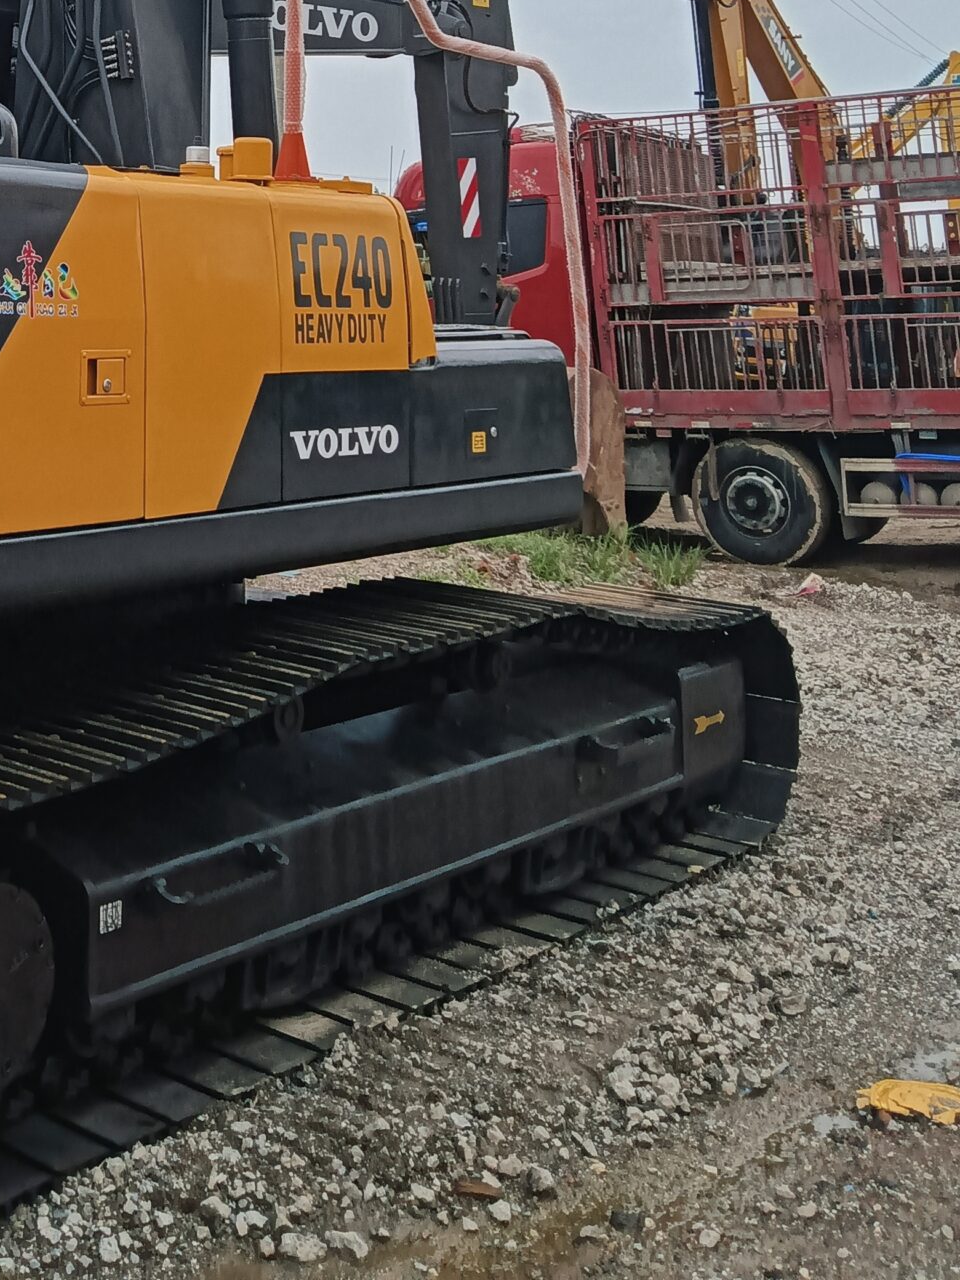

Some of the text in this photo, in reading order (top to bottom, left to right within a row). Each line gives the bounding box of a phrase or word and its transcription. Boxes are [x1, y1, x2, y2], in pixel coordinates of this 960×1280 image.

[271, 0, 378, 42] OLVO
[769, 19, 795, 71] SANY
[289, 231, 393, 309] EC240
[36, 303, 55, 316] KAO
[58, 304, 68, 317] ZI
[294, 313, 387, 345] HEAVY DUTY
[289, 424, 399, 460] VOLVO
